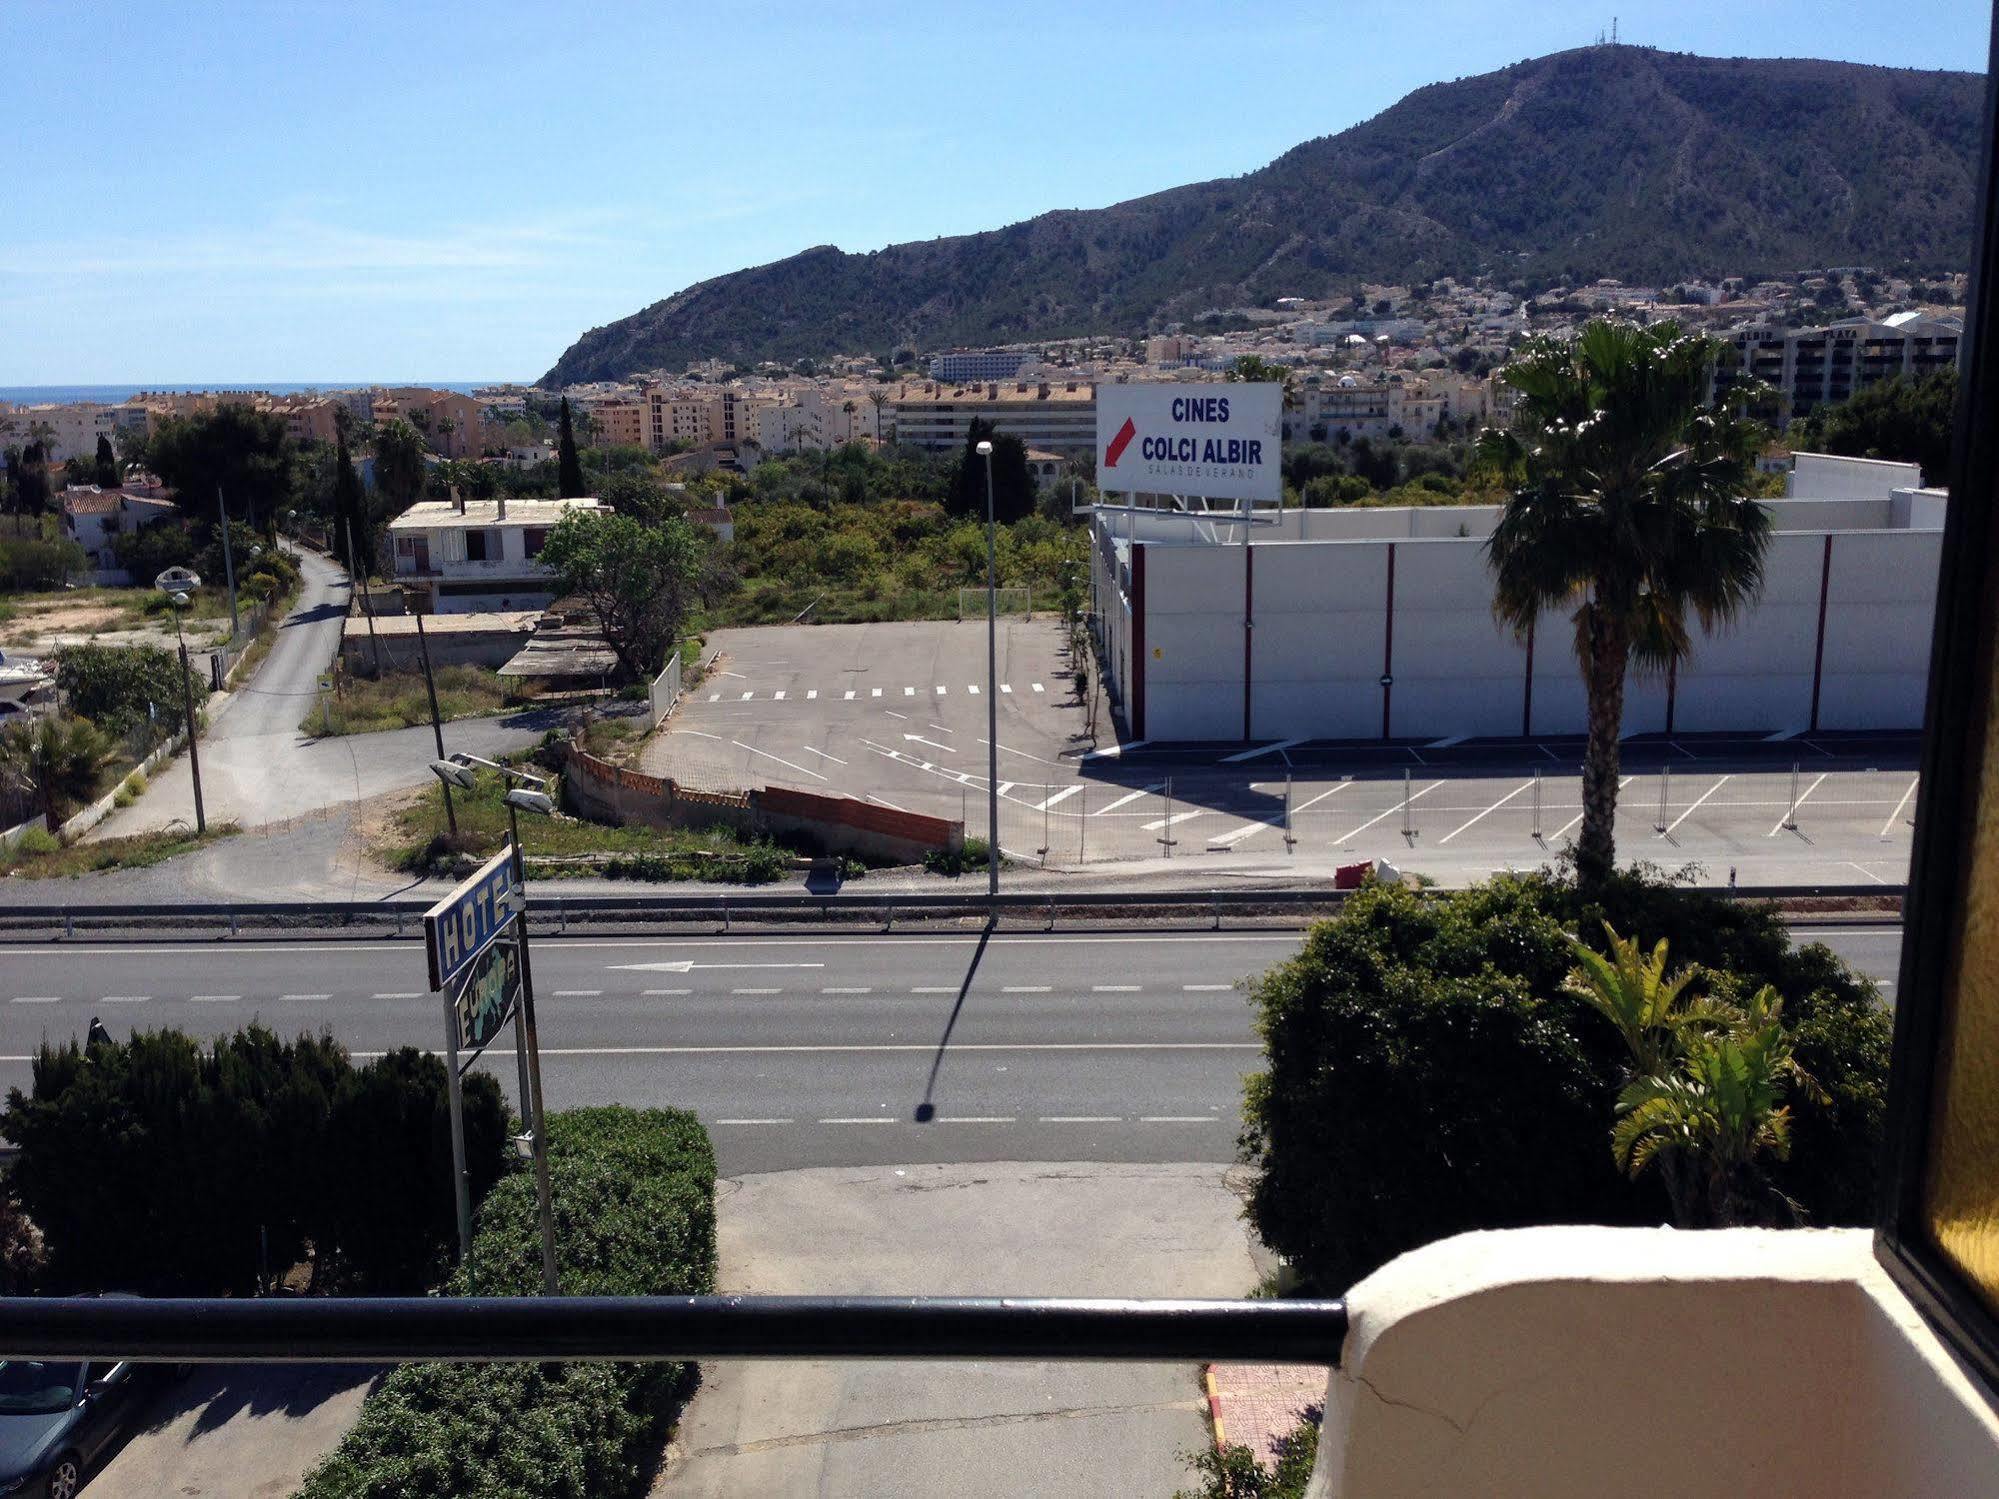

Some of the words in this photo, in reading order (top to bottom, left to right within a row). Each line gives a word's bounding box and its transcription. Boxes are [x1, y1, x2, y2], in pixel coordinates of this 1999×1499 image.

[1172, 397, 1230, 423] CINES
[1142, 437, 1196, 462] COLCI
[1202, 438, 1263, 465] ALBIR
[1148, 464, 1183, 476] SALAS
[1187, 466, 1201, 477] DE
[1206, 467, 1254, 479] VERANO
[459, 949, 515, 1048] EUROPA
